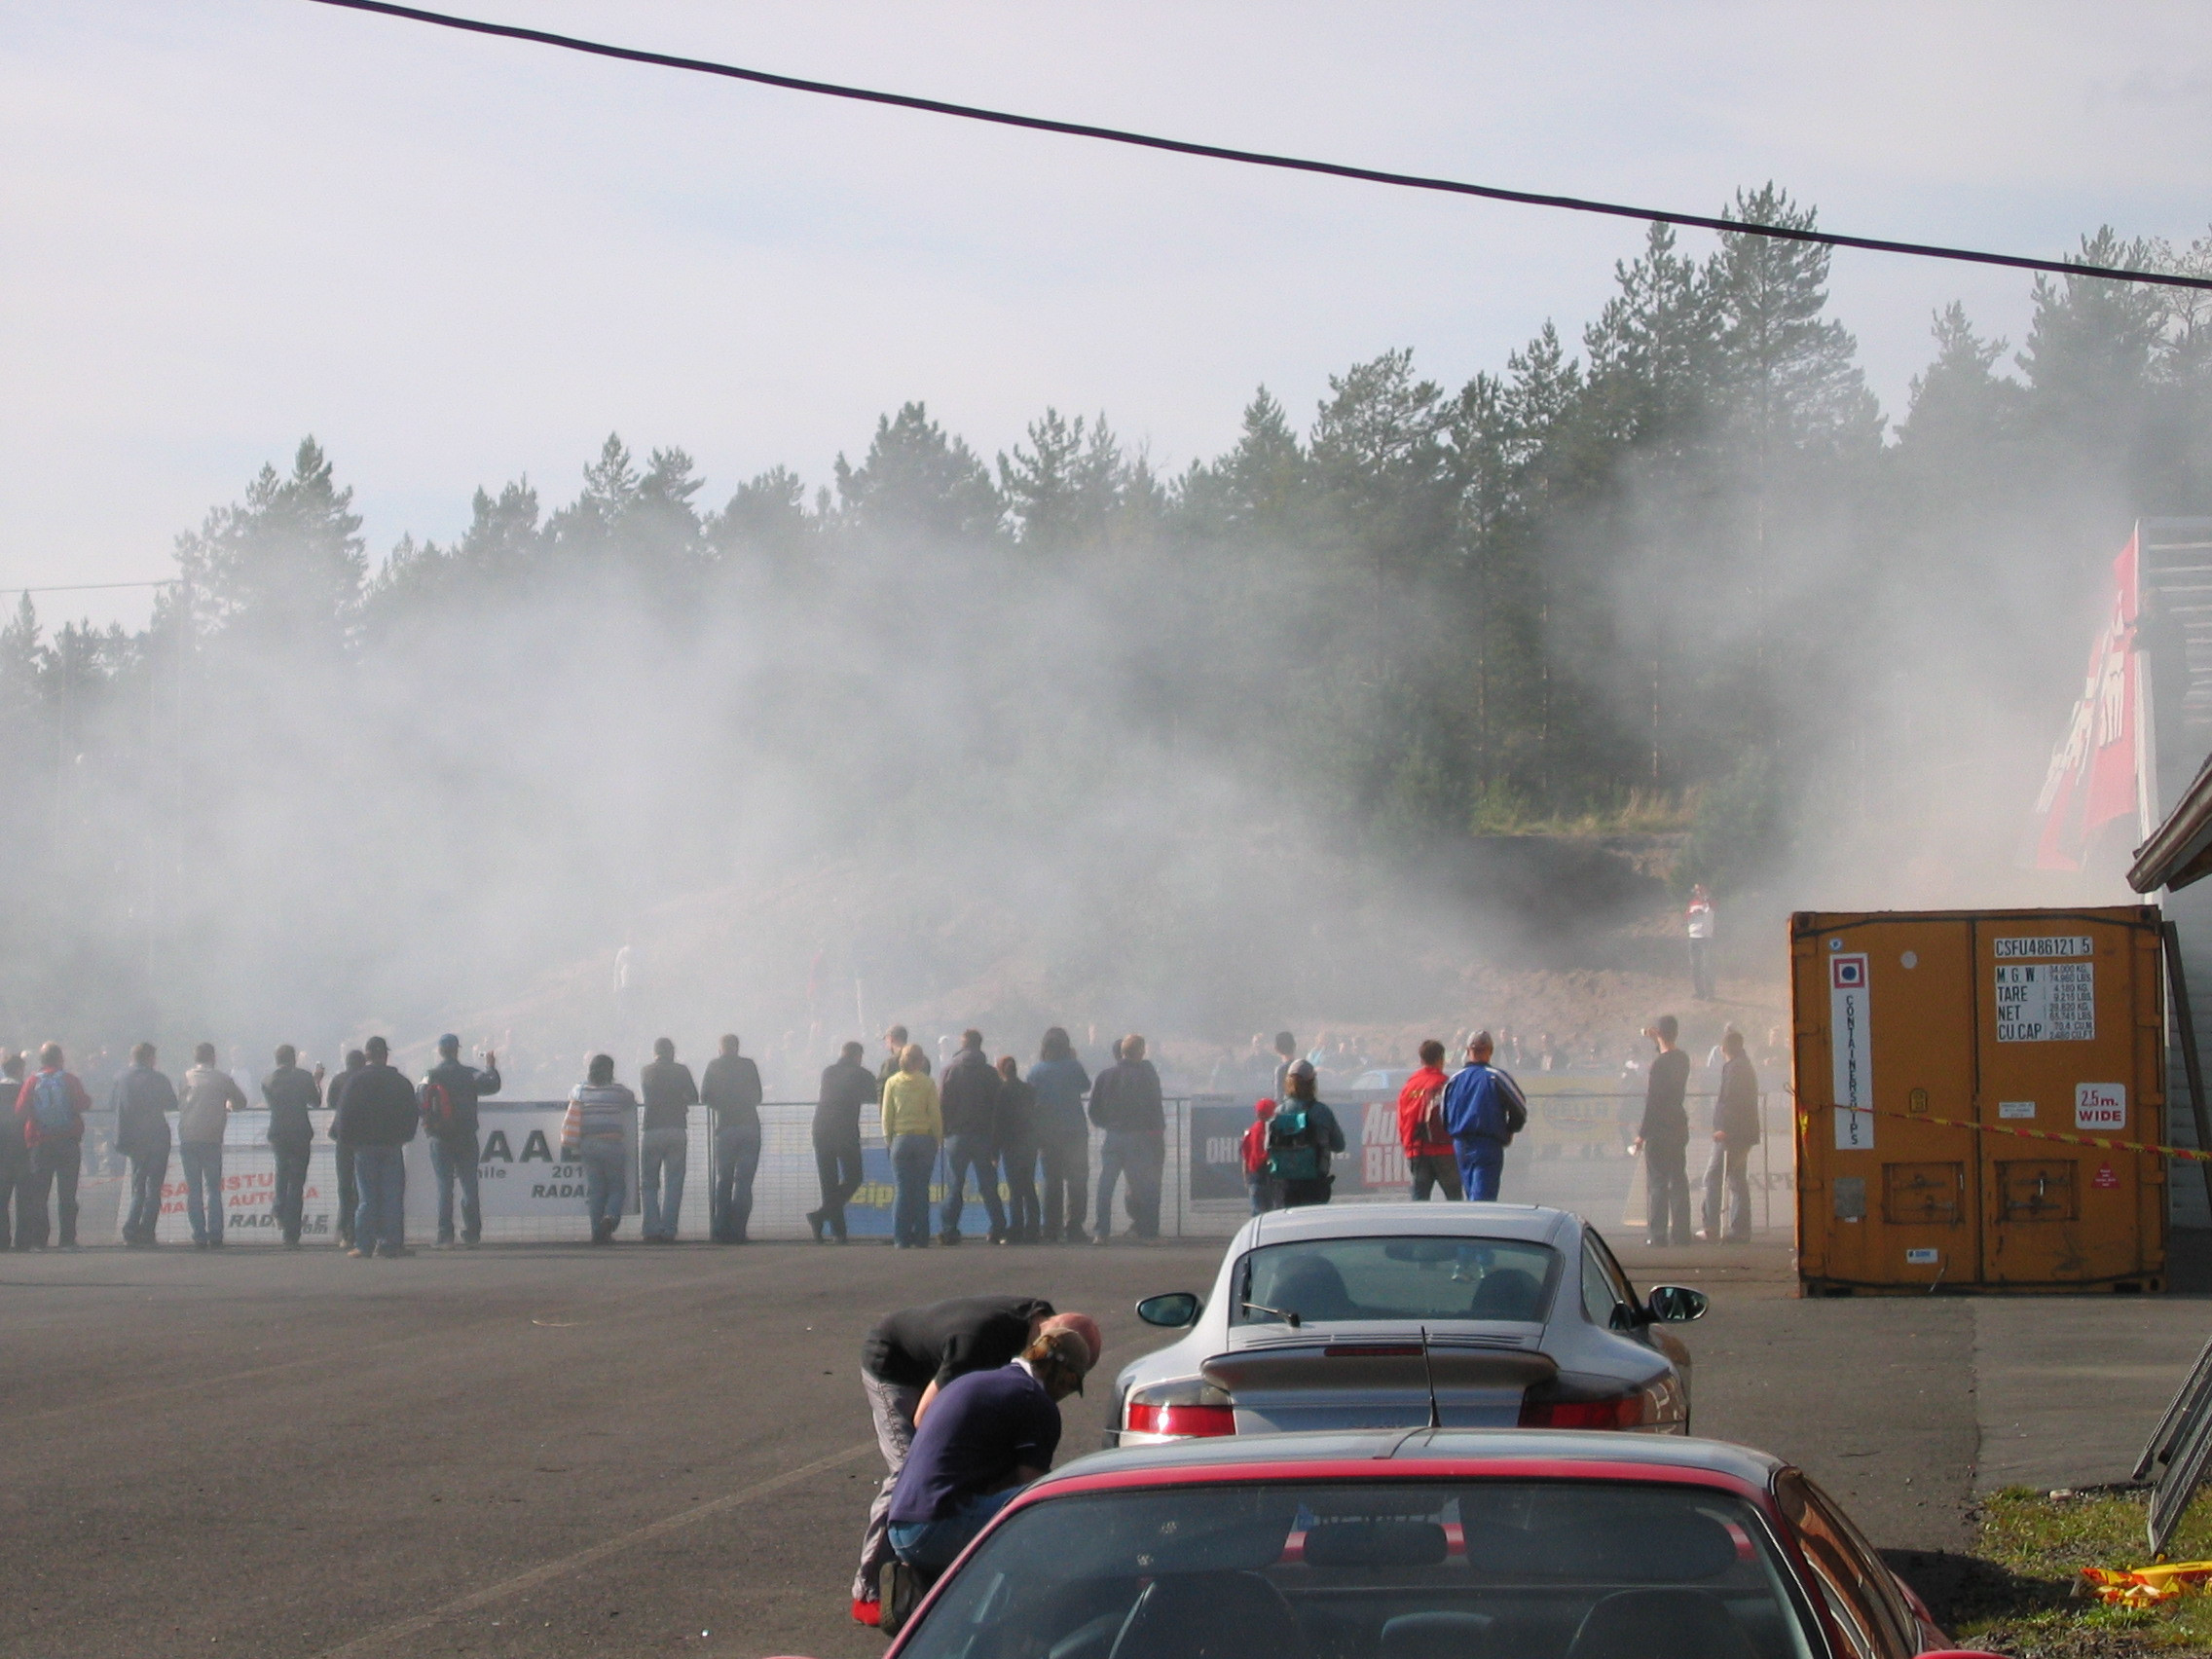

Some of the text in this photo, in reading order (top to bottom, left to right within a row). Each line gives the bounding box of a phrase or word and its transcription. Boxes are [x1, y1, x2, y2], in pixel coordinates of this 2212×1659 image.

[1996, 938, 2090, 956] CSFU486121 5
[1998, 985, 2029, 1002] TARE
[1998, 1005, 2022, 1021] NET
[2079, 1110, 2122, 1122] WIDE
[531, 1184, 590, 1198] RADA
